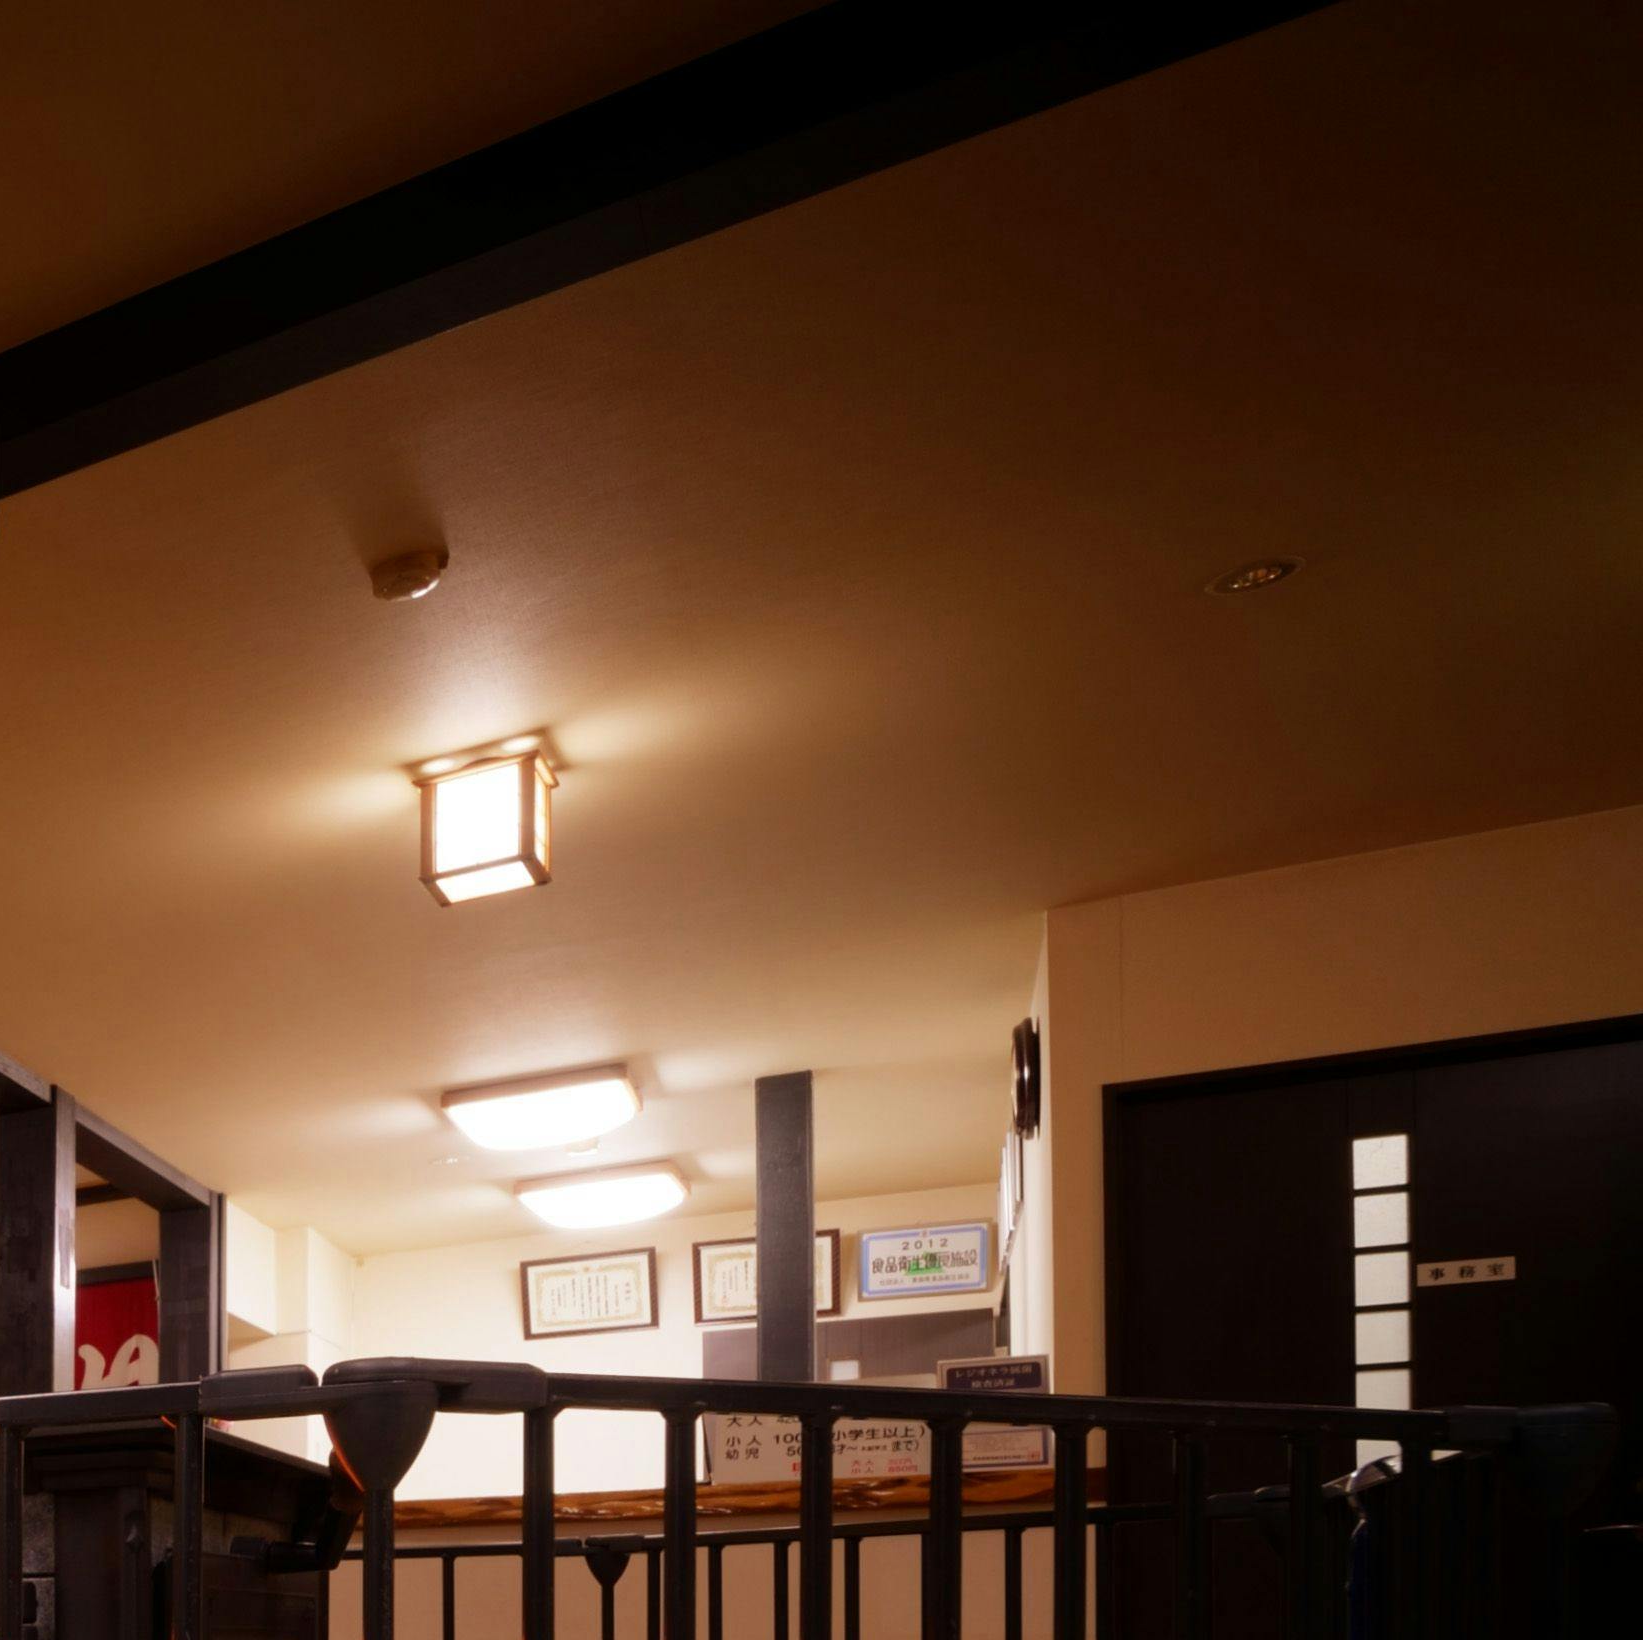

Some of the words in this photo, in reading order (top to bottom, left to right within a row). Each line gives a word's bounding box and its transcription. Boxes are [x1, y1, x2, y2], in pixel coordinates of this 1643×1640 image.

[901, 1238, 949, 1251] 2012
[1428, 1263, 1505, 1280] 事務室
[726, 1435, 763, 1445] 小人
[725, 1447, 760, 1460] 幼児
